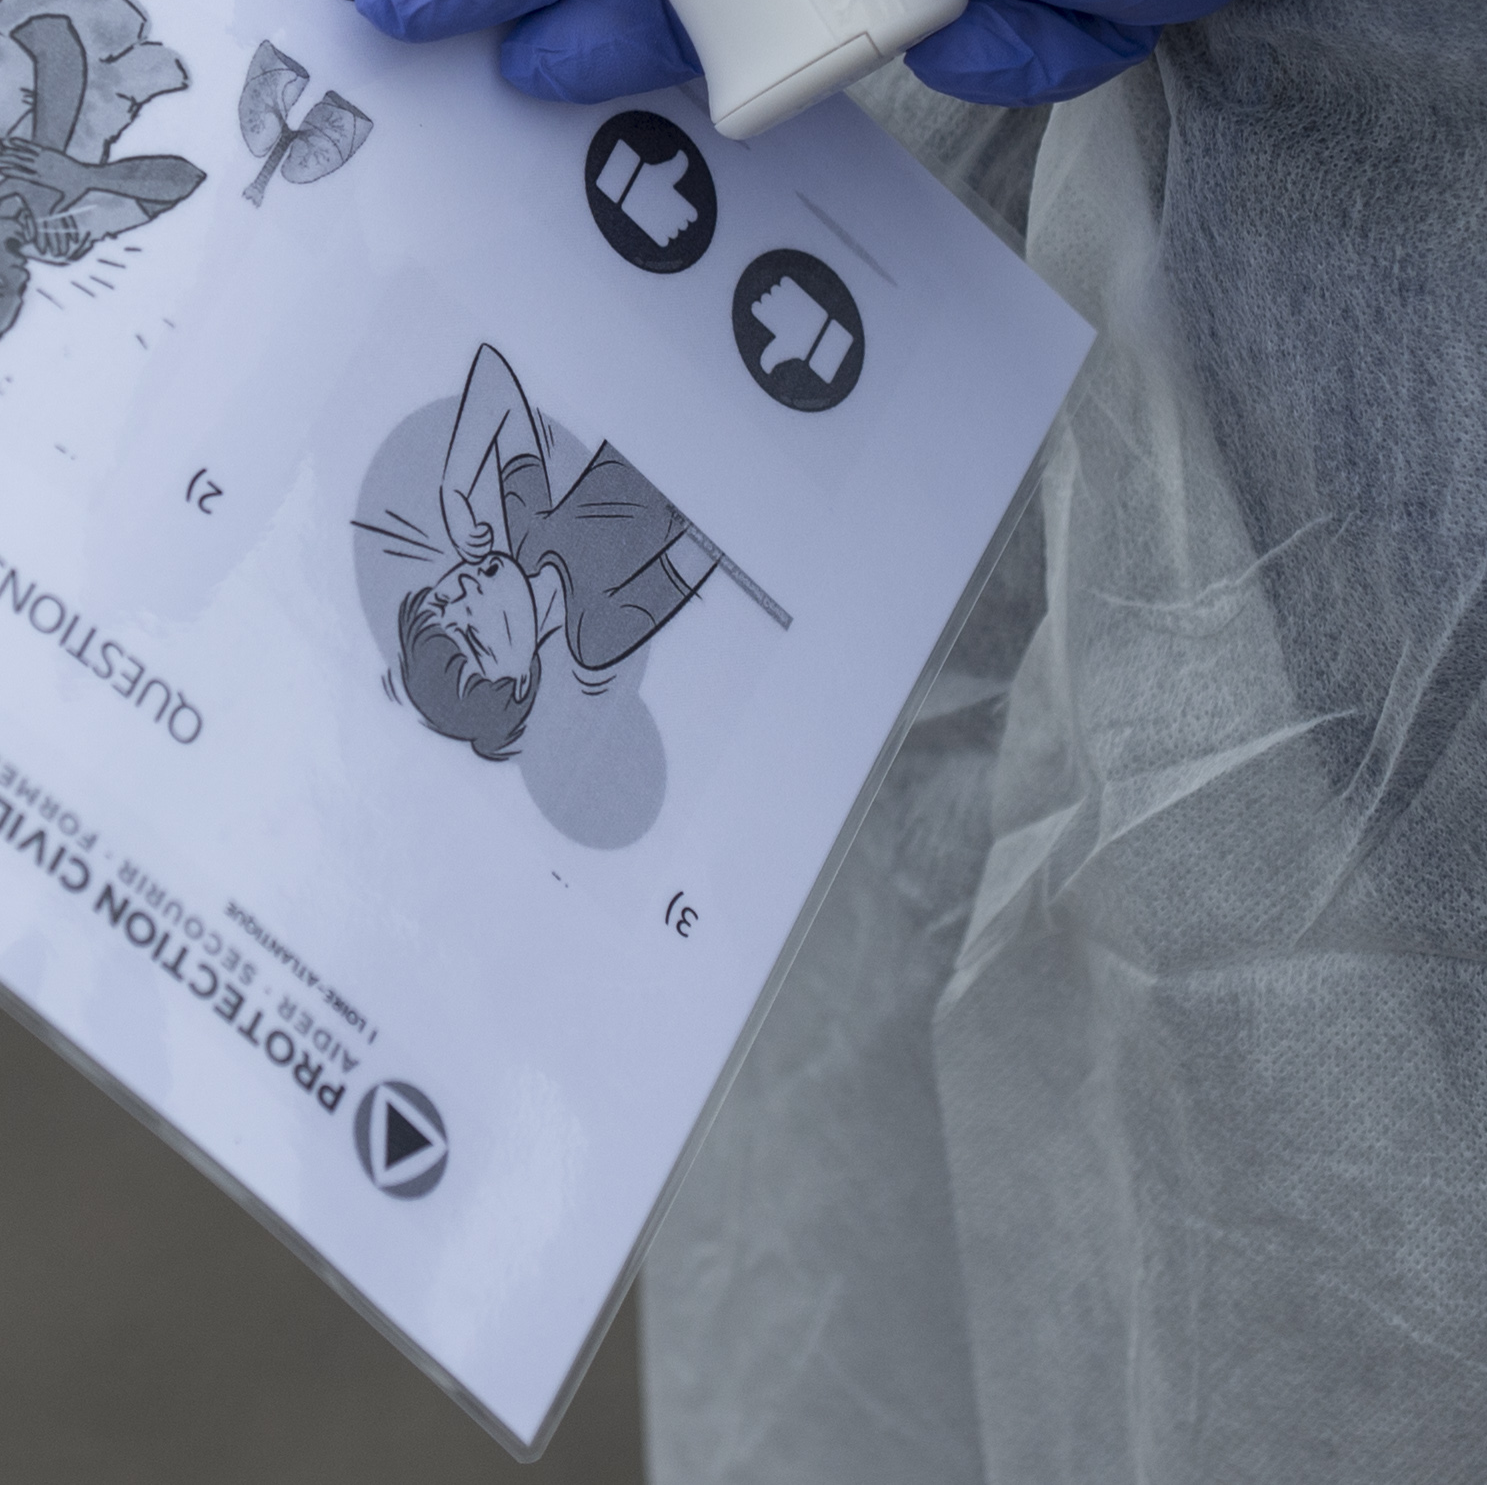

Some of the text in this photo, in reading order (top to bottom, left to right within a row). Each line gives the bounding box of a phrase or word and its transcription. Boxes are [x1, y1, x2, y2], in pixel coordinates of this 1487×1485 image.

[185, 468, 223, 515] 2)
[116, 858, 259, 986] SECOURIR
[665, 891, 699, 938] 3)
[92, 882, 348, 1115] PROTECTION
[223, 901, 370, 1033] LOIRE-ATLANTIQUE
[277, 994, 360, 1074] AIDER
